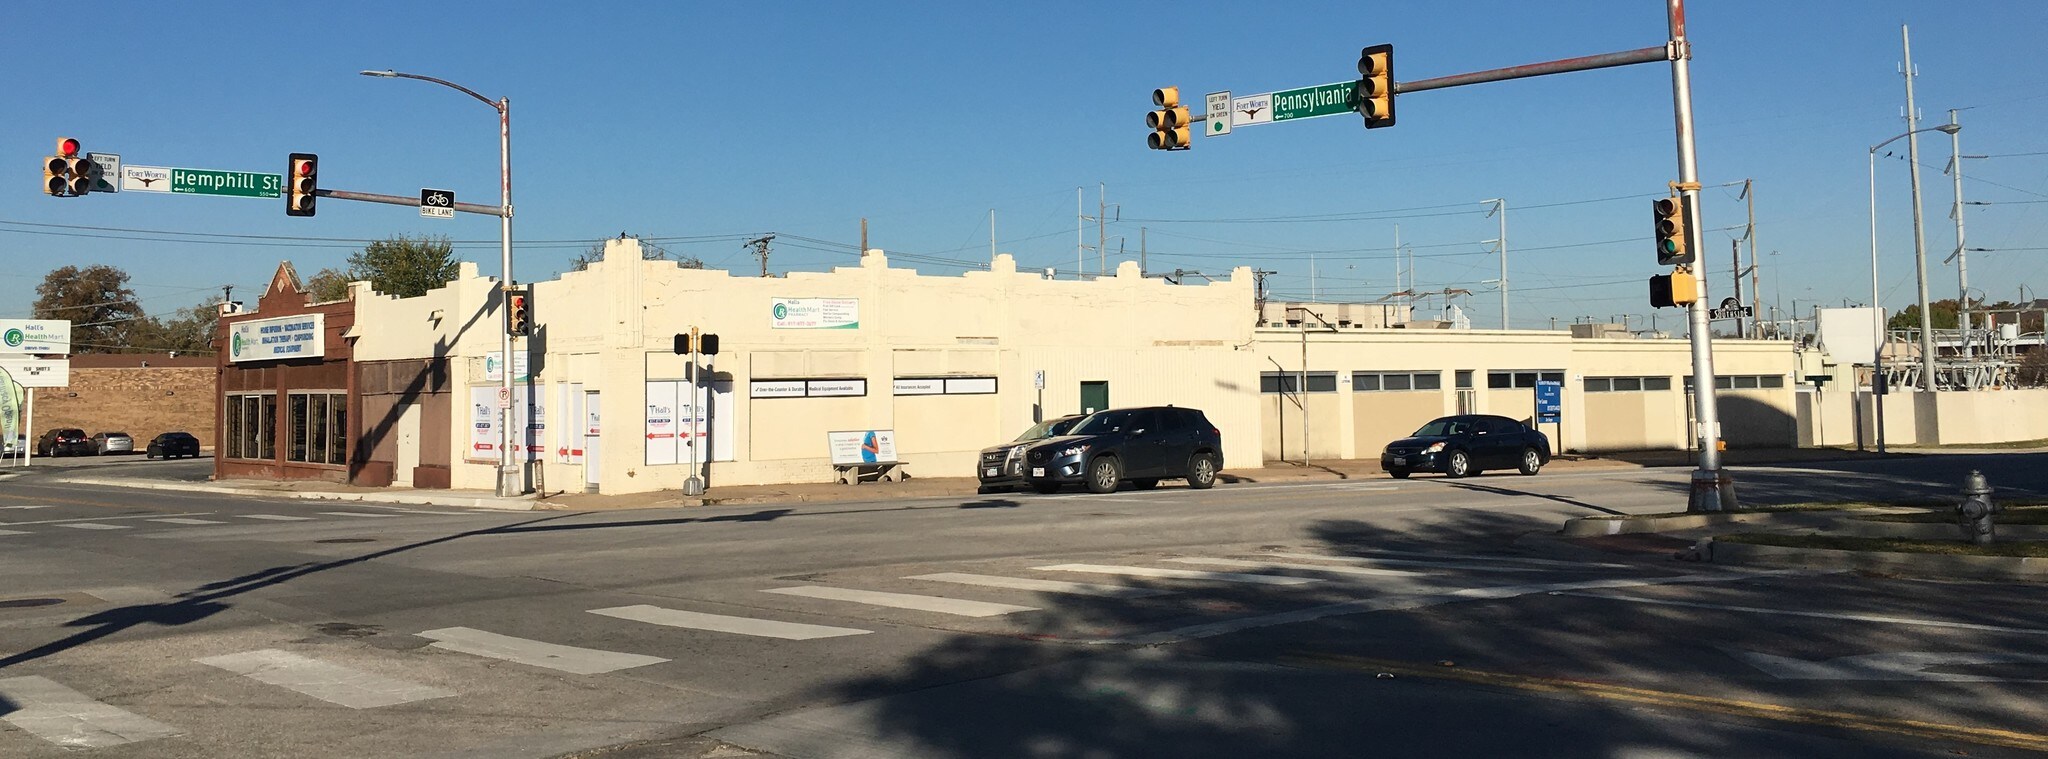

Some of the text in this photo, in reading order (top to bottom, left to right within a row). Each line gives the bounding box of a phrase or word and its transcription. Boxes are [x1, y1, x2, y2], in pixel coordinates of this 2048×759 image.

[1274, 84, 1352, 112] Pennsylvania
[174, 171, 278, 190] Hemphill St
[1714, 308, 1748, 318] SOUTHSIDE
